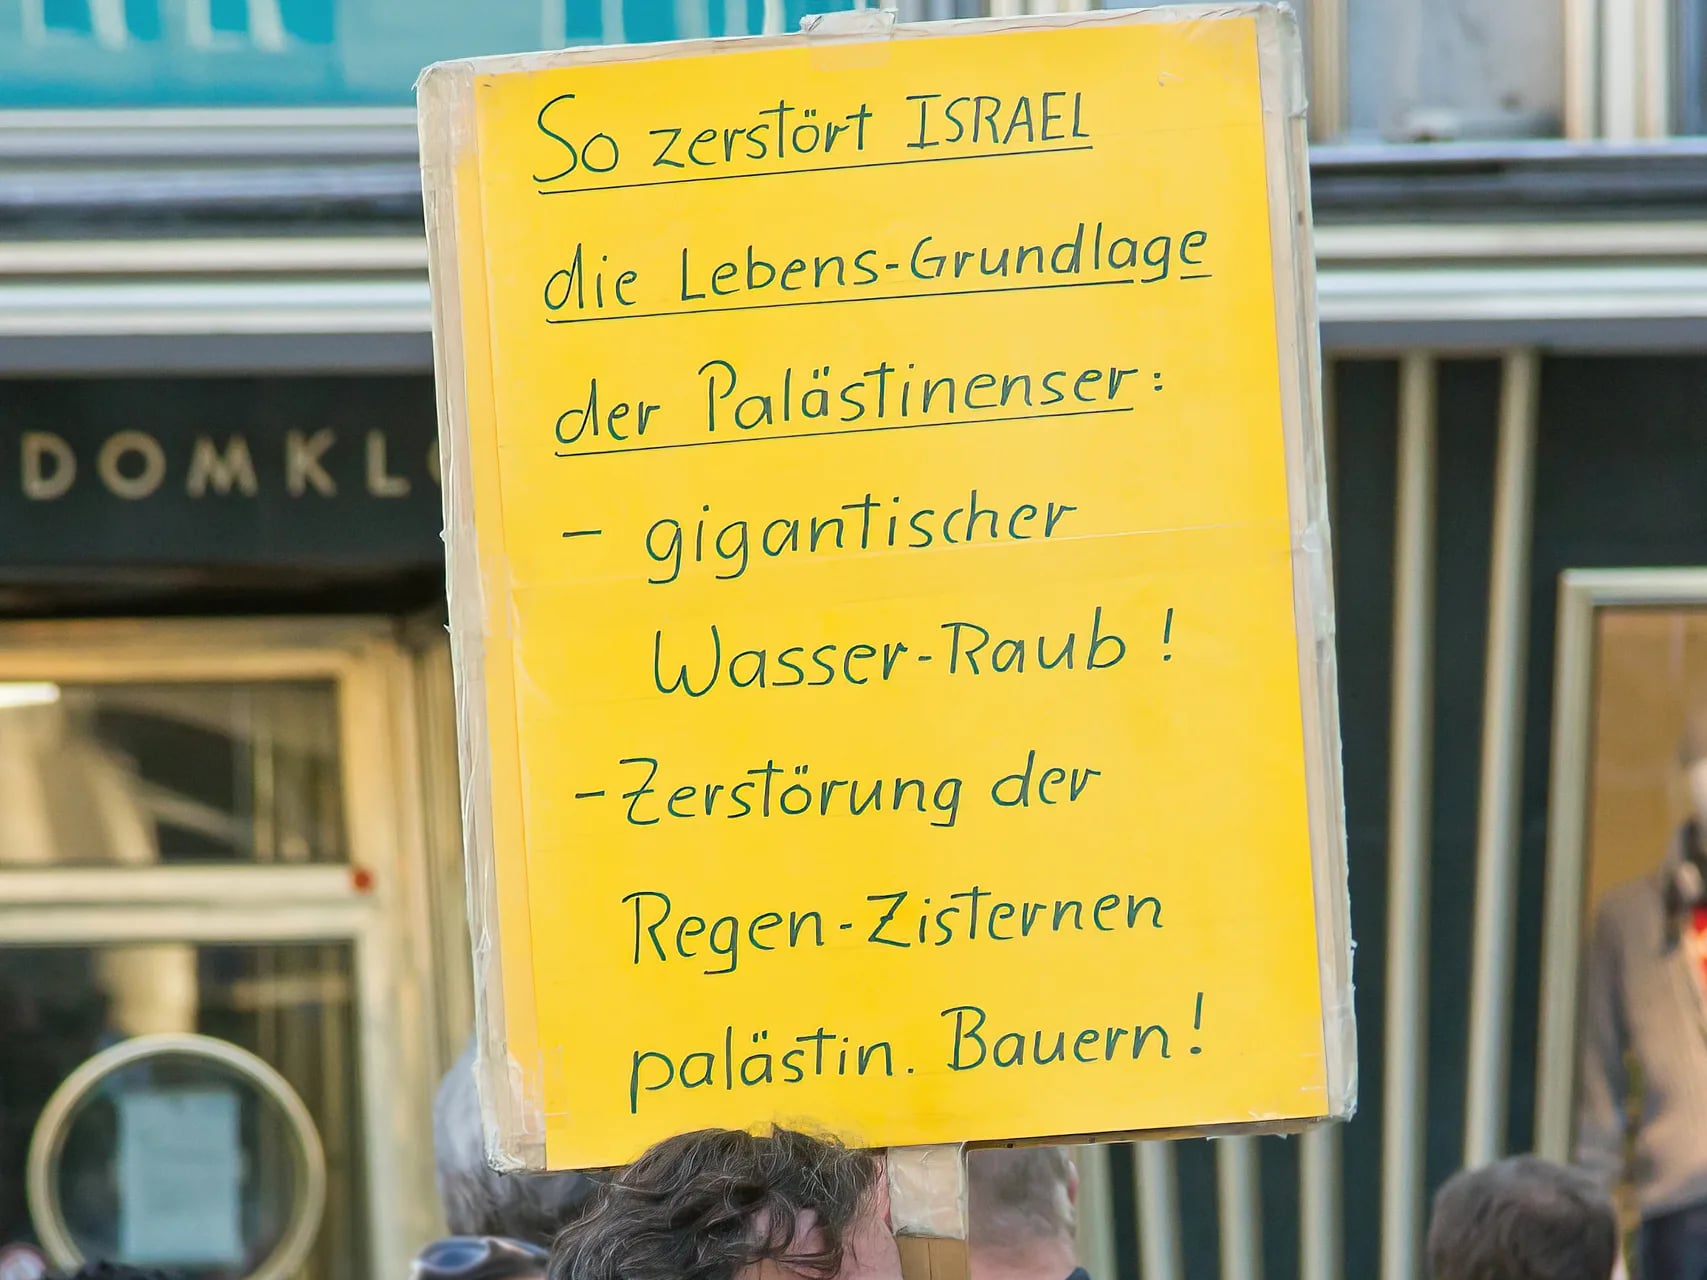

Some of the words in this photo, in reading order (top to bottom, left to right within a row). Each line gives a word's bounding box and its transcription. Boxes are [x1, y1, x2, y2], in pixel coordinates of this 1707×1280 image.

[532, 93, 619, 183] So
[649, 99, 873, 168] zerstört
[905, 91, 1090, 150] ISRAEL
[544, 242, 638, 311] die
[681, 222, 1209, 302] Lebens-Grundlage
[555, 378, 661, 445] der
[20, 429, 441, 500] DOMKL
[645, 489, 1078, 585] gigantischer
[991, 749, 1102, 808] der
[621, 885, 1163, 975] Regen-Zisternen
[629, 1025, 914, 1115] palästin.
[940, 991, 1204, 1072] Bauern!
